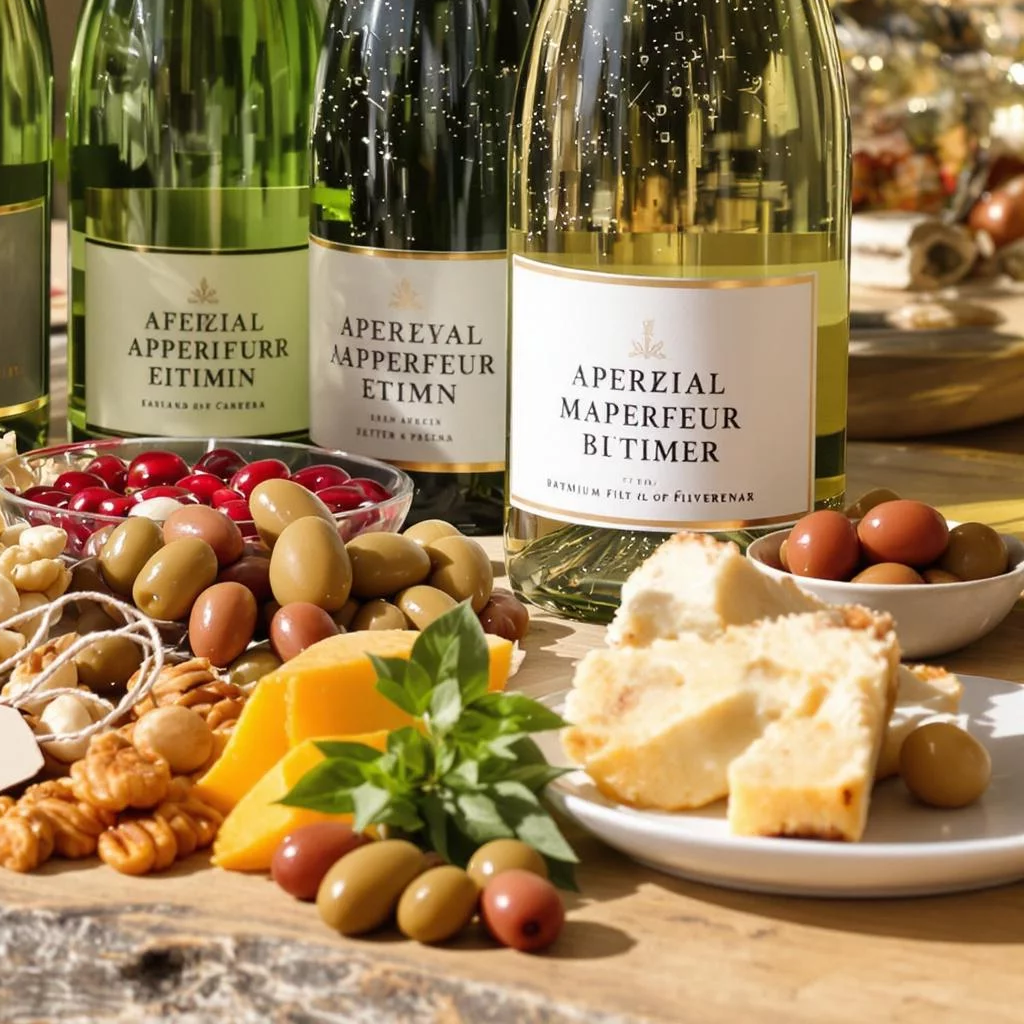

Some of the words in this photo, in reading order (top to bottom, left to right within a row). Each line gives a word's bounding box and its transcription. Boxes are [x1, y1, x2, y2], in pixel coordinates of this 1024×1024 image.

[149, 366, 255, 388] EITIMIN
[362, 378, 456, 404] ETIMN
[560, 397, 741, 429] MAPERFEUR
